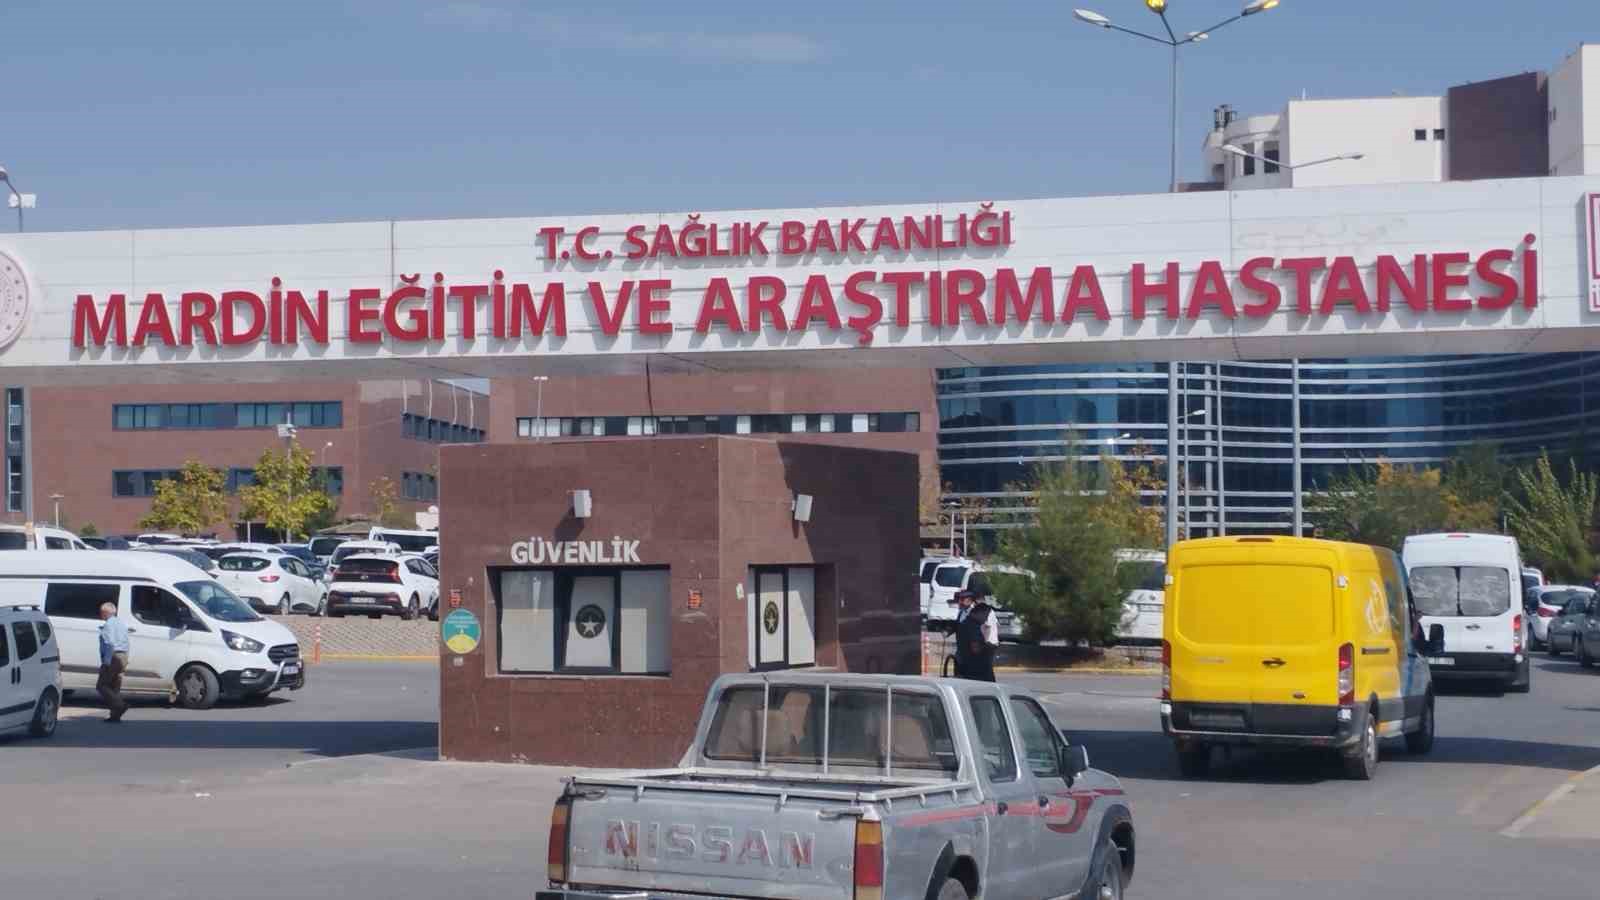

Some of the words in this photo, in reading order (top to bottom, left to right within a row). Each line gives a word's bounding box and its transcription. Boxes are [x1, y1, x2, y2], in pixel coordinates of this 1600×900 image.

[540, 226, 613, 260] T.C.
[627, 214, 768, 258] SAĞLIK
[782, 202, 1011, 254] BAKANLIĞI
[74, 276, 329, 347] MARDİN
[349, 271, 566, 343] EĞİTİM
[588, 278, 672, 335] VE
[696, 264, 1110, 346] ARAŞTIRMA
[1131, 234, 1537, 320] HASTANESİ
[510, 535, 641, 565] GÜVENLİK
[604, 819, 816, 870] NISSAN
